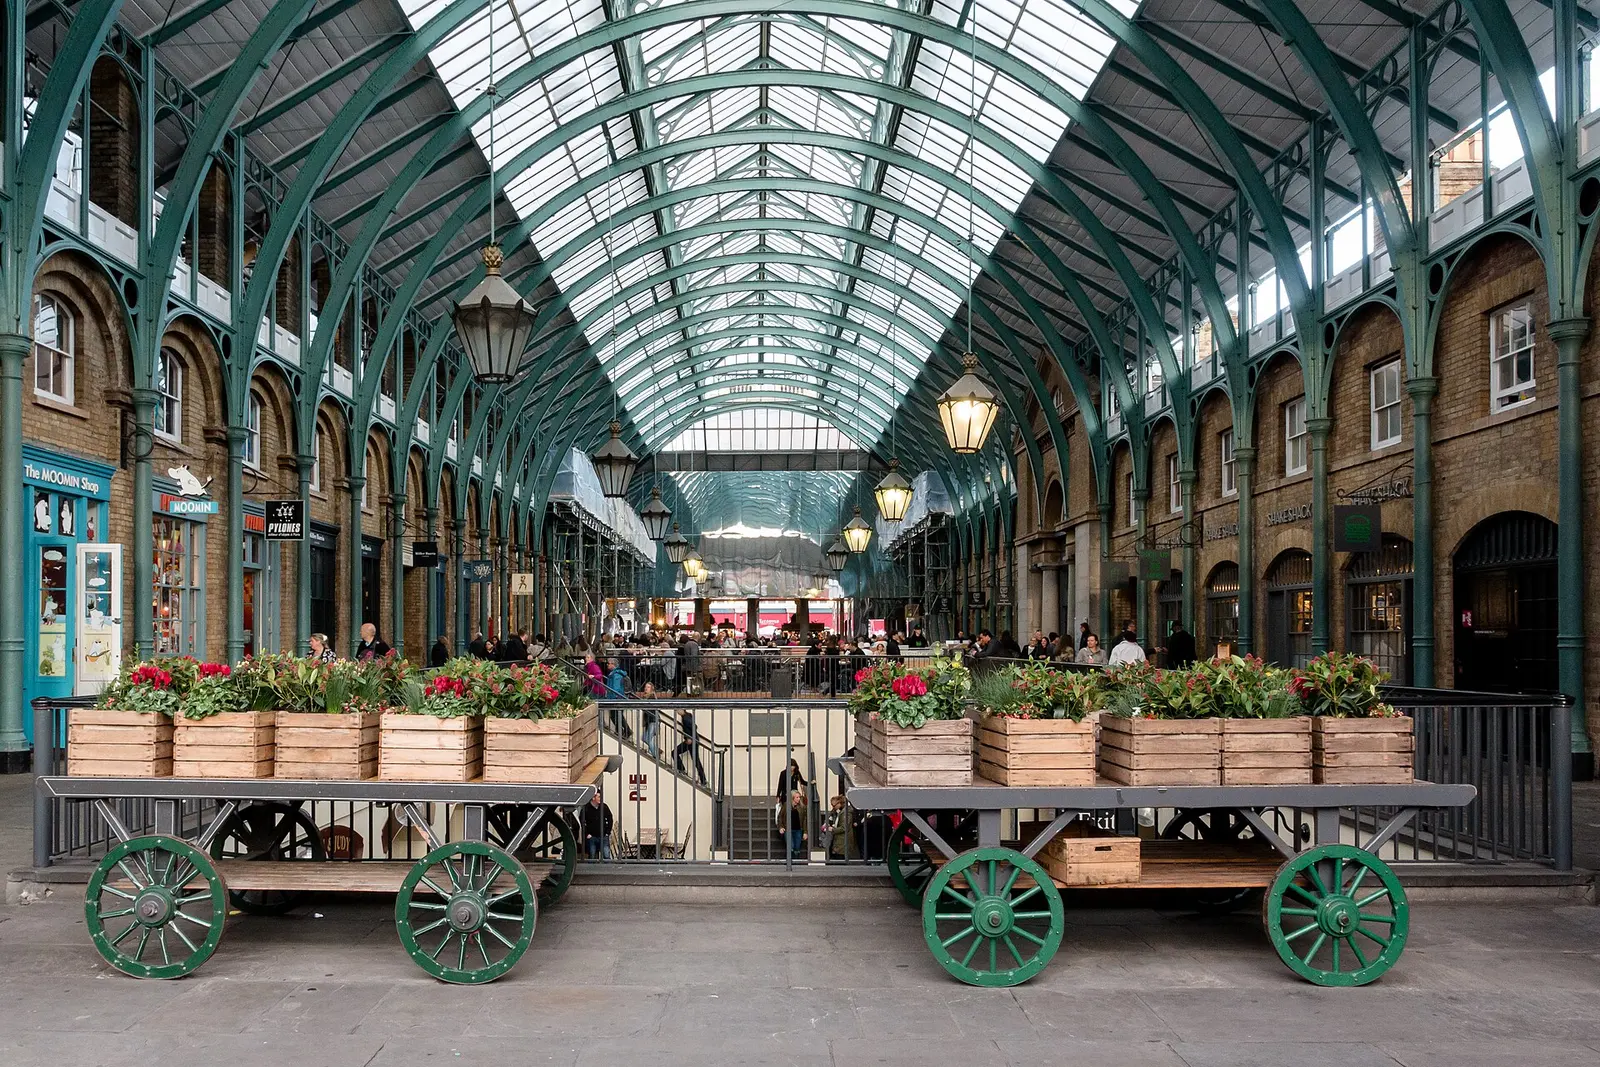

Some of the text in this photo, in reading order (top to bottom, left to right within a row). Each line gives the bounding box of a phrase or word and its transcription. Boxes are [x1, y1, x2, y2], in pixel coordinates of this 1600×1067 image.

[24, 464, 99, 495] The MOOMIN Shop
[173, 501, 212, 513] MOOMIN
[268, 522, 301, 533] PYLONES
[333, 835, 351, 853] JUDY
